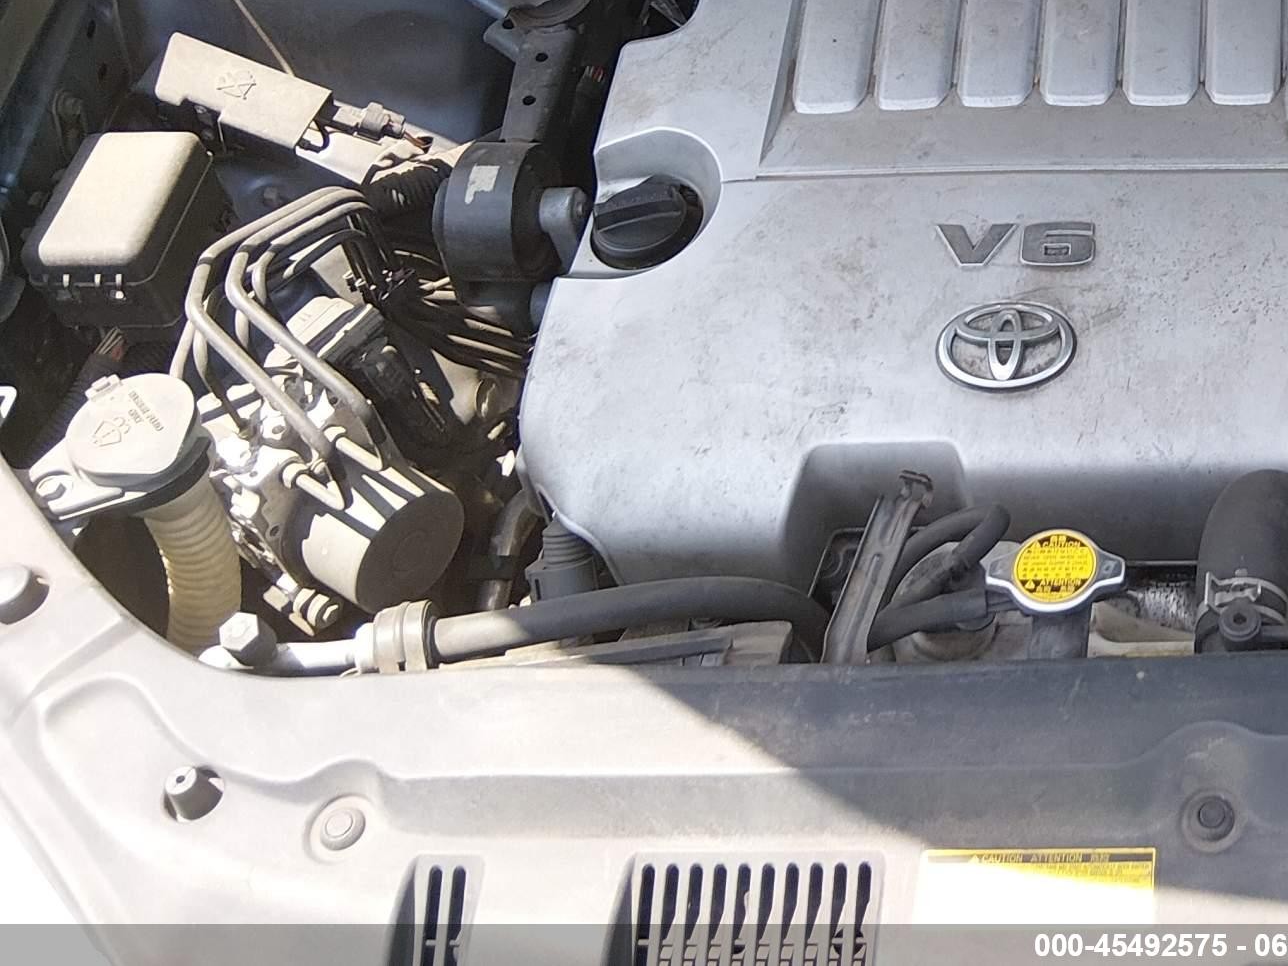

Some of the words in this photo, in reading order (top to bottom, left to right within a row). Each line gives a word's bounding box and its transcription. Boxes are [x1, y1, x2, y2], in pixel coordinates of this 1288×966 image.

[935, 221, 1096, 267] V6
[981, 853, 1023, 863] CAUTION
[1030, 852, 1083, 863] ATTENTION
